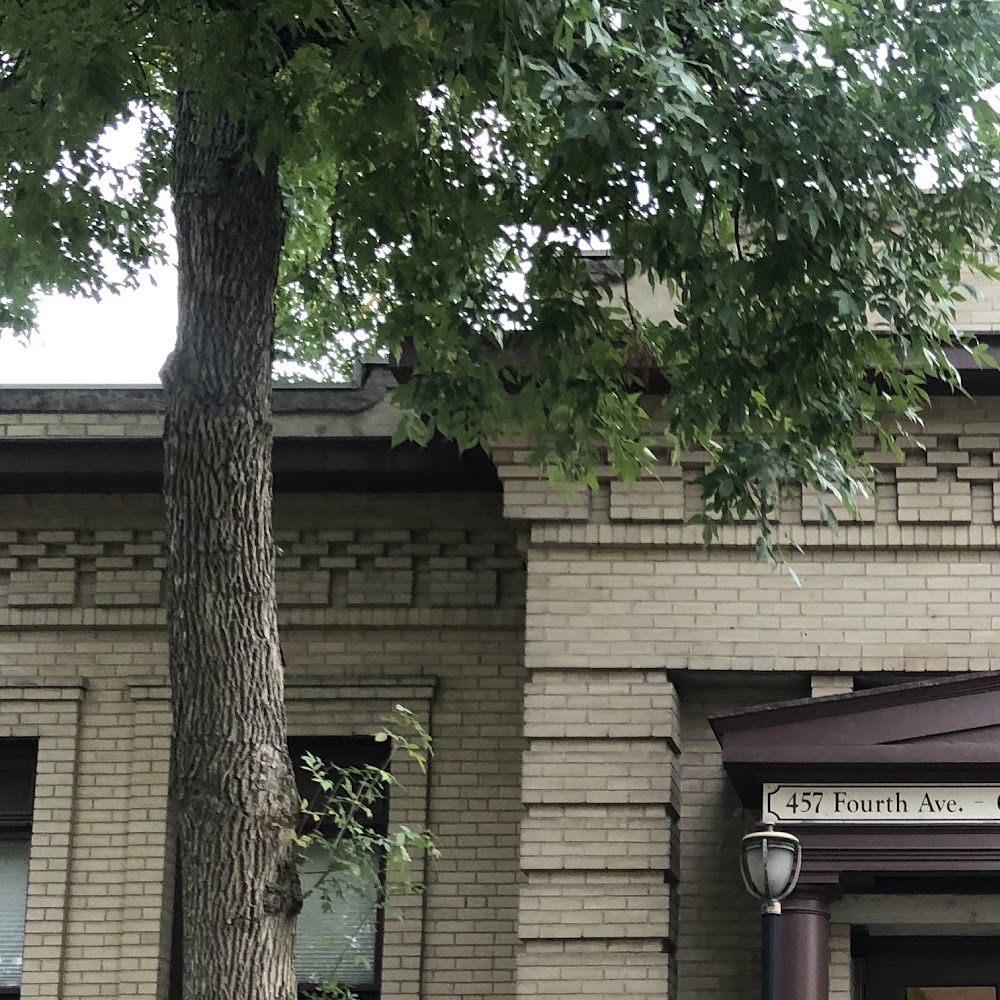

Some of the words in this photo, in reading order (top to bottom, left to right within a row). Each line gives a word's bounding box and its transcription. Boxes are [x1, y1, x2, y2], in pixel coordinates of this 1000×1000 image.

[786, 792, 824, 814] 457
[833, 792, 908, 813] Fourth
[918, 792, 963, 813] Ave.
